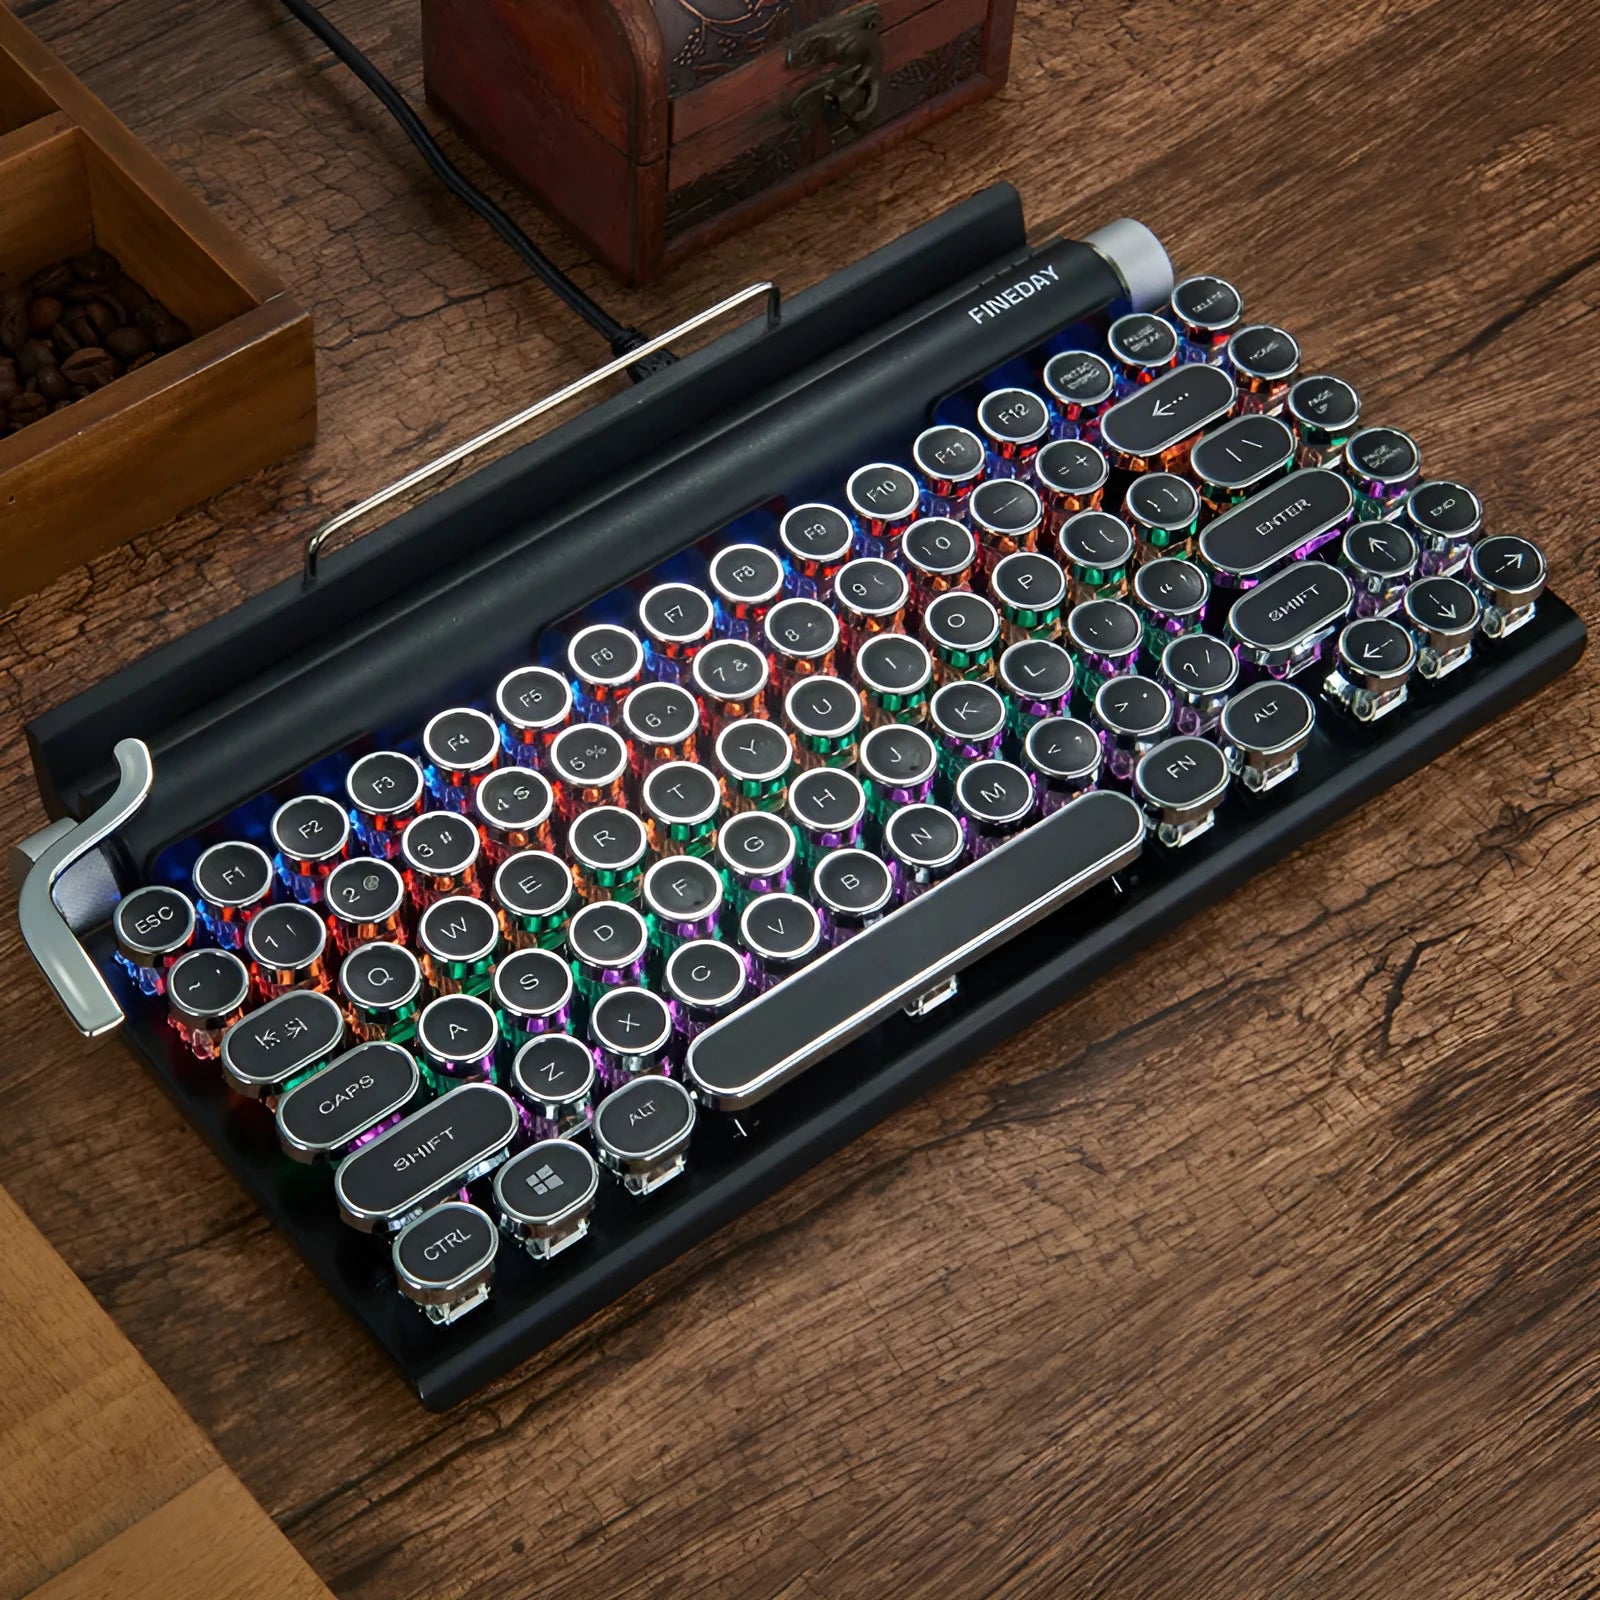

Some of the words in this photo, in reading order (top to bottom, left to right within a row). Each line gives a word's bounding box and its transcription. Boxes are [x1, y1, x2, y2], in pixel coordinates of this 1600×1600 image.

[968, 265, 1059, 324] FINEDAY
[998, 403, 1030, 425] F12
[934, 442, 966, 464] F11
[866, 480, 897, 503] F10
[1255, 498, 1311, 536] ENTER
[803, 523, 827, 541] F9
[1268, 584, 1320, 622] SHIFT
[663, 604, 684, 624] F7
[1023, 664, 1046, 678] L
[519, 689, 543, 708] F5
[812, 698, 832, 715] U
[954, 701, 979, 721] K
[1253, 701, 1279, 723] ALT
[447, 733, 470, 752] F4
[585, 744, 608, 760] %
[1166, 754, 1197, 779] FN
[371, 776, 395, 795] F3
[666, 783, 685, 800] T
[980, 782, 1007, 803] M
[812, 788, 836, 809] H
[298, 819, 323, 839] F2
[593, 830, 616, 848] R
[910, 827, 933, 846] N
[743, 836, 765, 853] G
[222, 866, 246, 886] F1
[517, 875, 543, 895] E
[840, 874, 860, 890] B
[341, 887, 361, 904] 2
[135, 907, 173, 934] ESC
[440, 916, 468, 939] W
[593, 924, 614, 942] D
[367, 967, 394, 987] Q
[519, 973, 540, 991] S
[691, 965, 711, 982] C
[448, 1023, 468, 1041] A
[617, 1013, 641, 1033] X
[539, 1061, 565, 1082] Z
[318, 1075, 374, 1115] CAPS
[629, 1100, 656, 1127] ALT
[393, 1126, 455, 1172] SHIFT
[423, 1228, 472, 1261] CTRL
